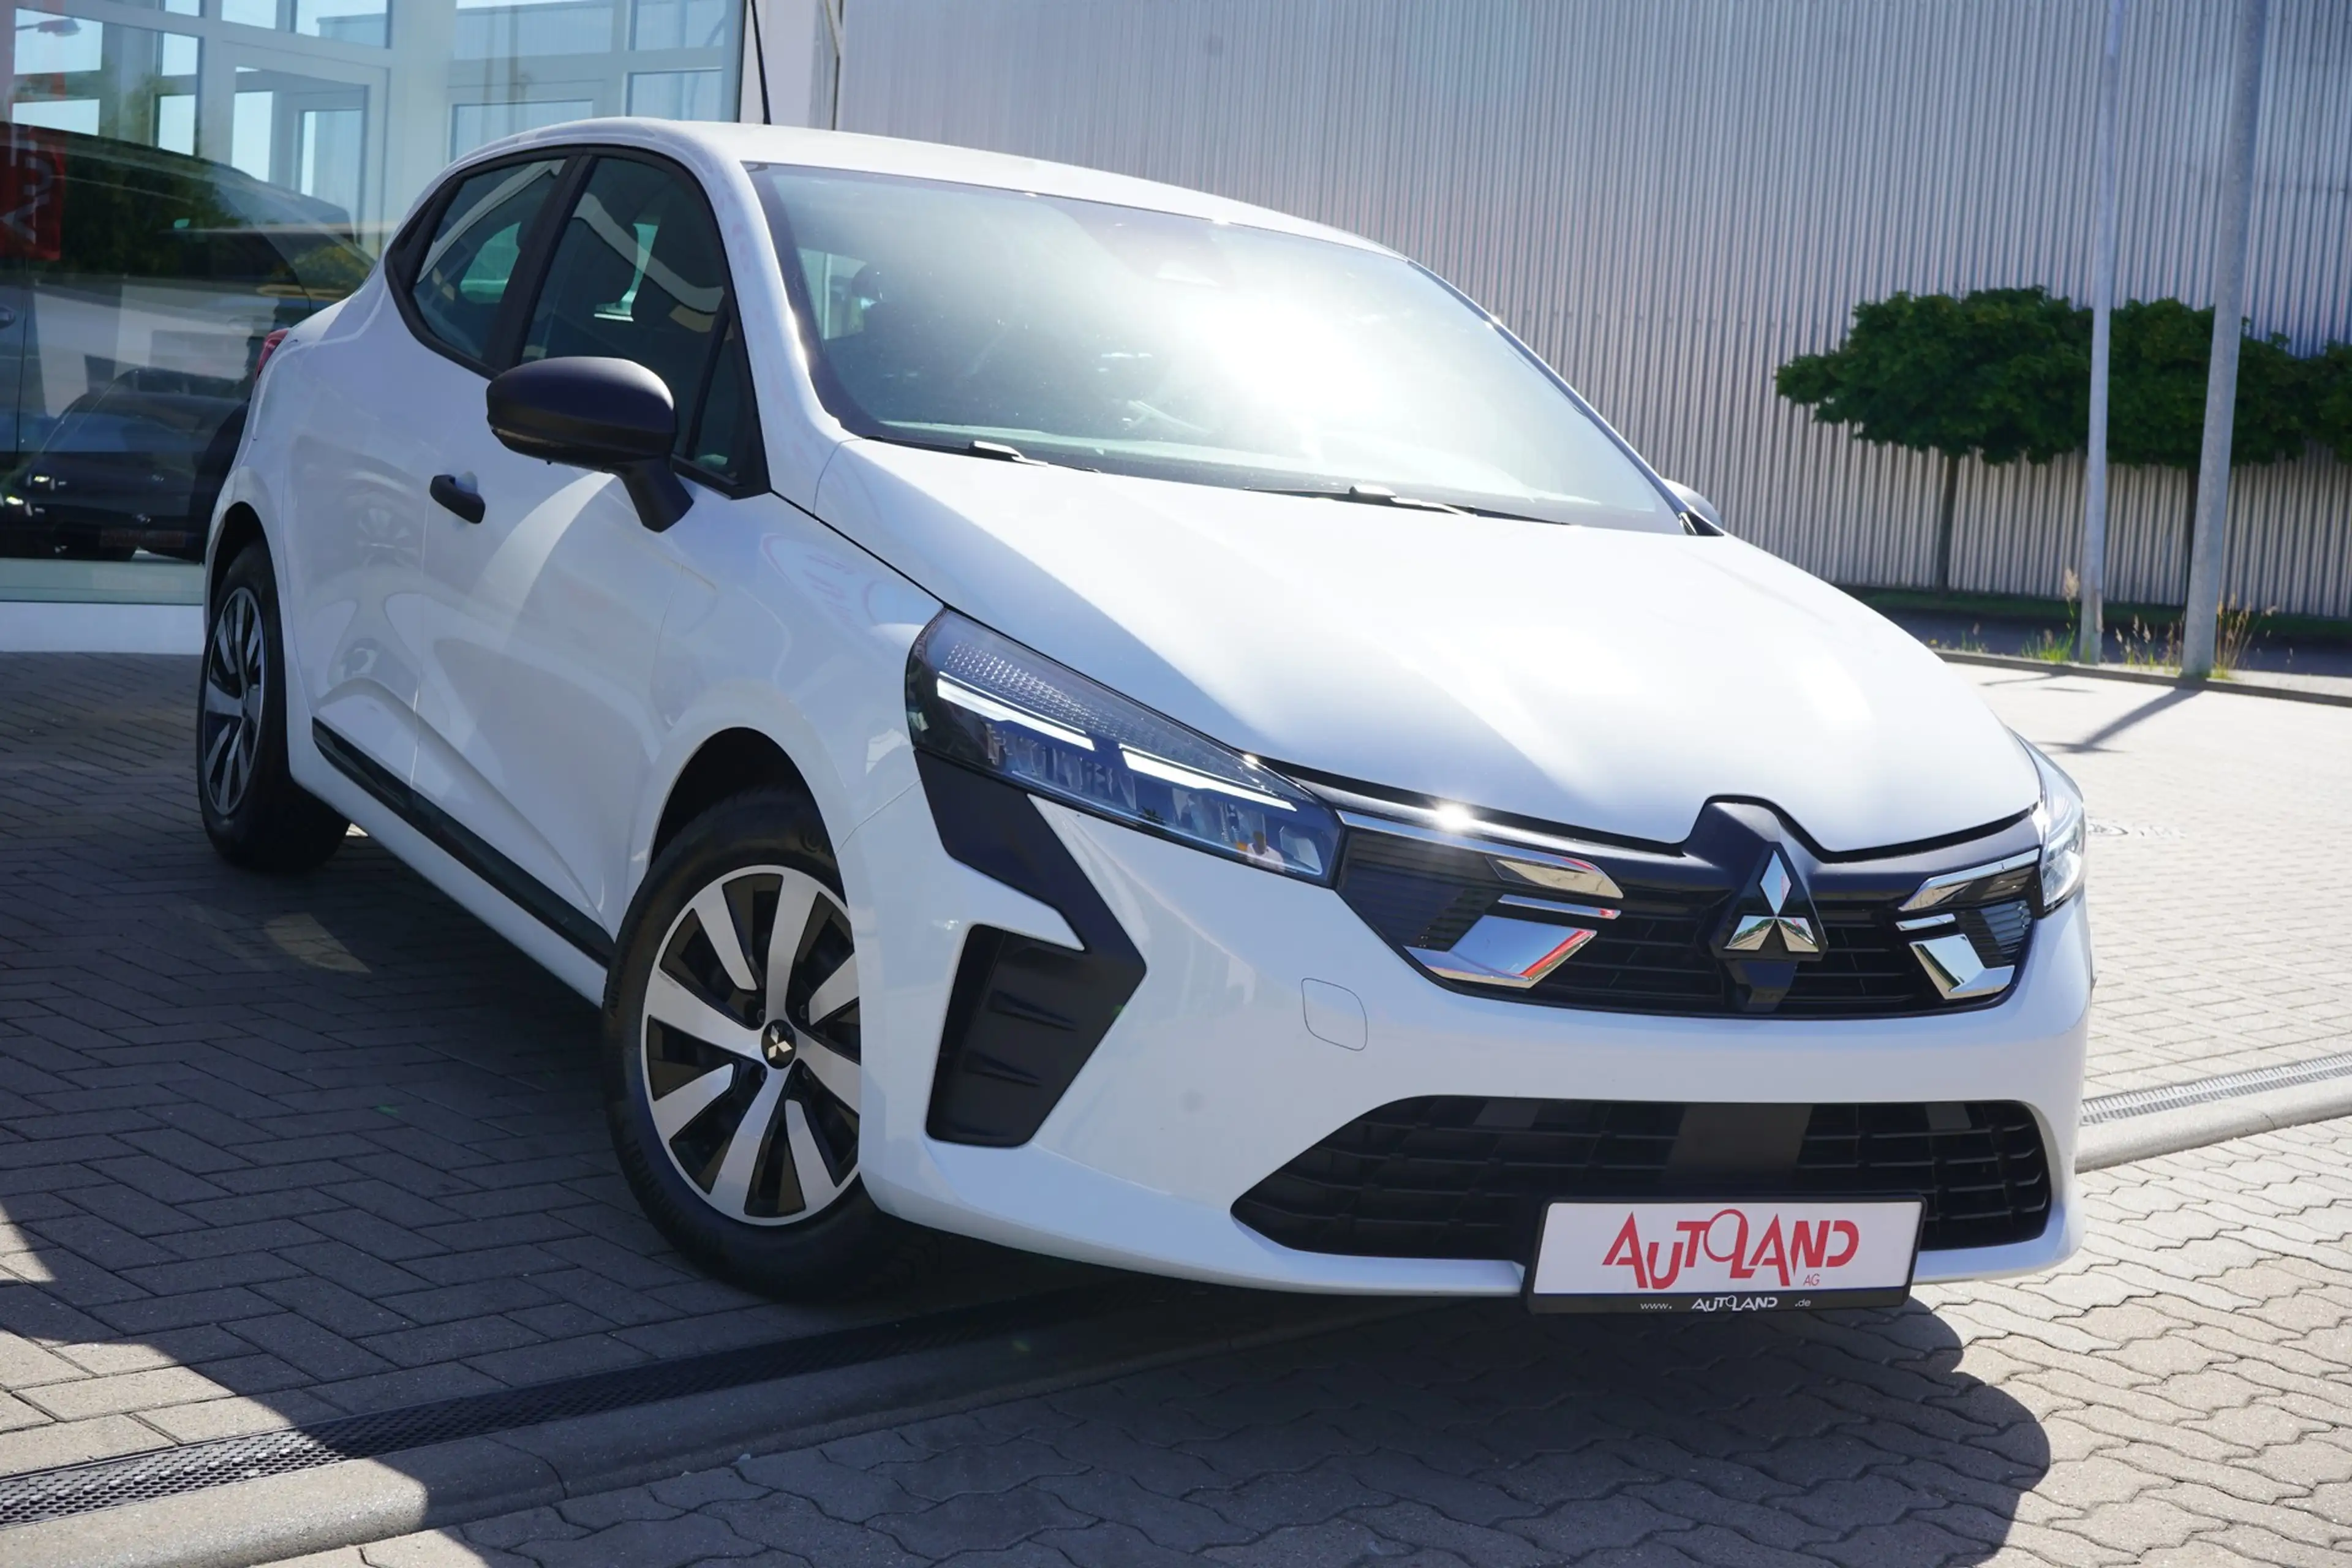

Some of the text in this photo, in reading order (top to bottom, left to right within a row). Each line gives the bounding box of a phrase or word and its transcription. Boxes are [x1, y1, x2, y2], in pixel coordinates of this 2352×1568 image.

[1602, 1209, 1860, 1289] AUTOLAND
[1803, 1273, 1820, 1286] AG
[1691, 1295, 1778, 1312] AUTOLAND
[1795, 1298, 1811, 1307] .de
